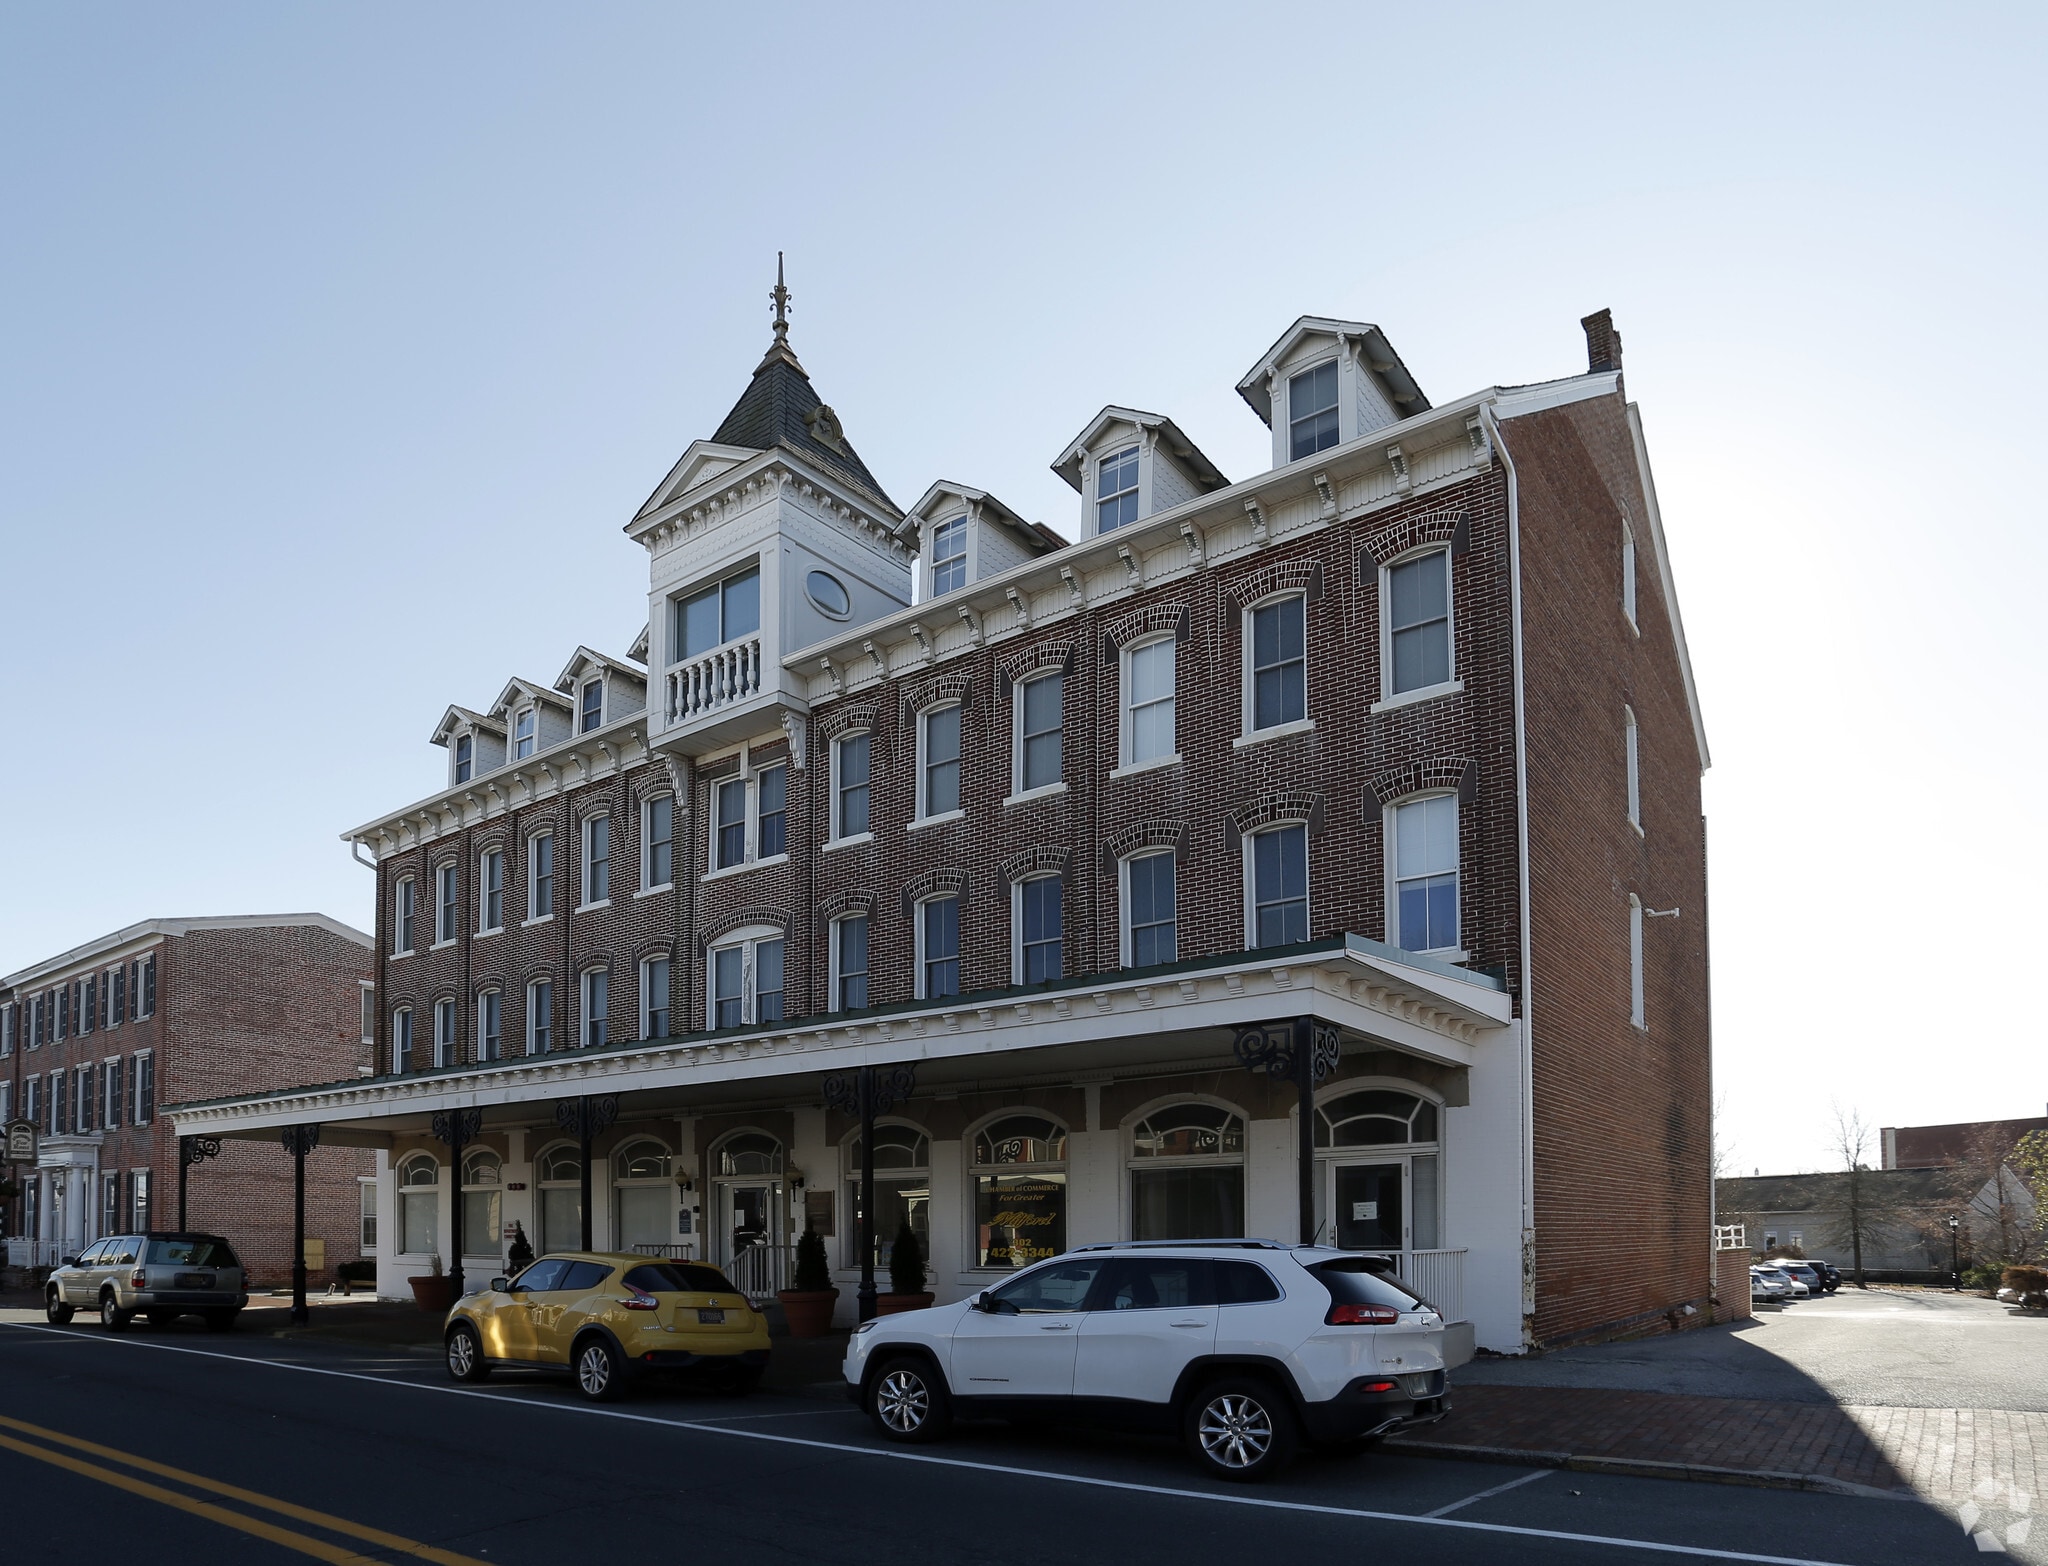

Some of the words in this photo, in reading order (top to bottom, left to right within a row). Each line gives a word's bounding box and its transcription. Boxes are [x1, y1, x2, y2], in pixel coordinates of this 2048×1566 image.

[987, 1211, 1056, 1228] Milford
[1013, 1238, 1032, 1246] 302
[991, 1247, 1055, 1258] 422-3344
